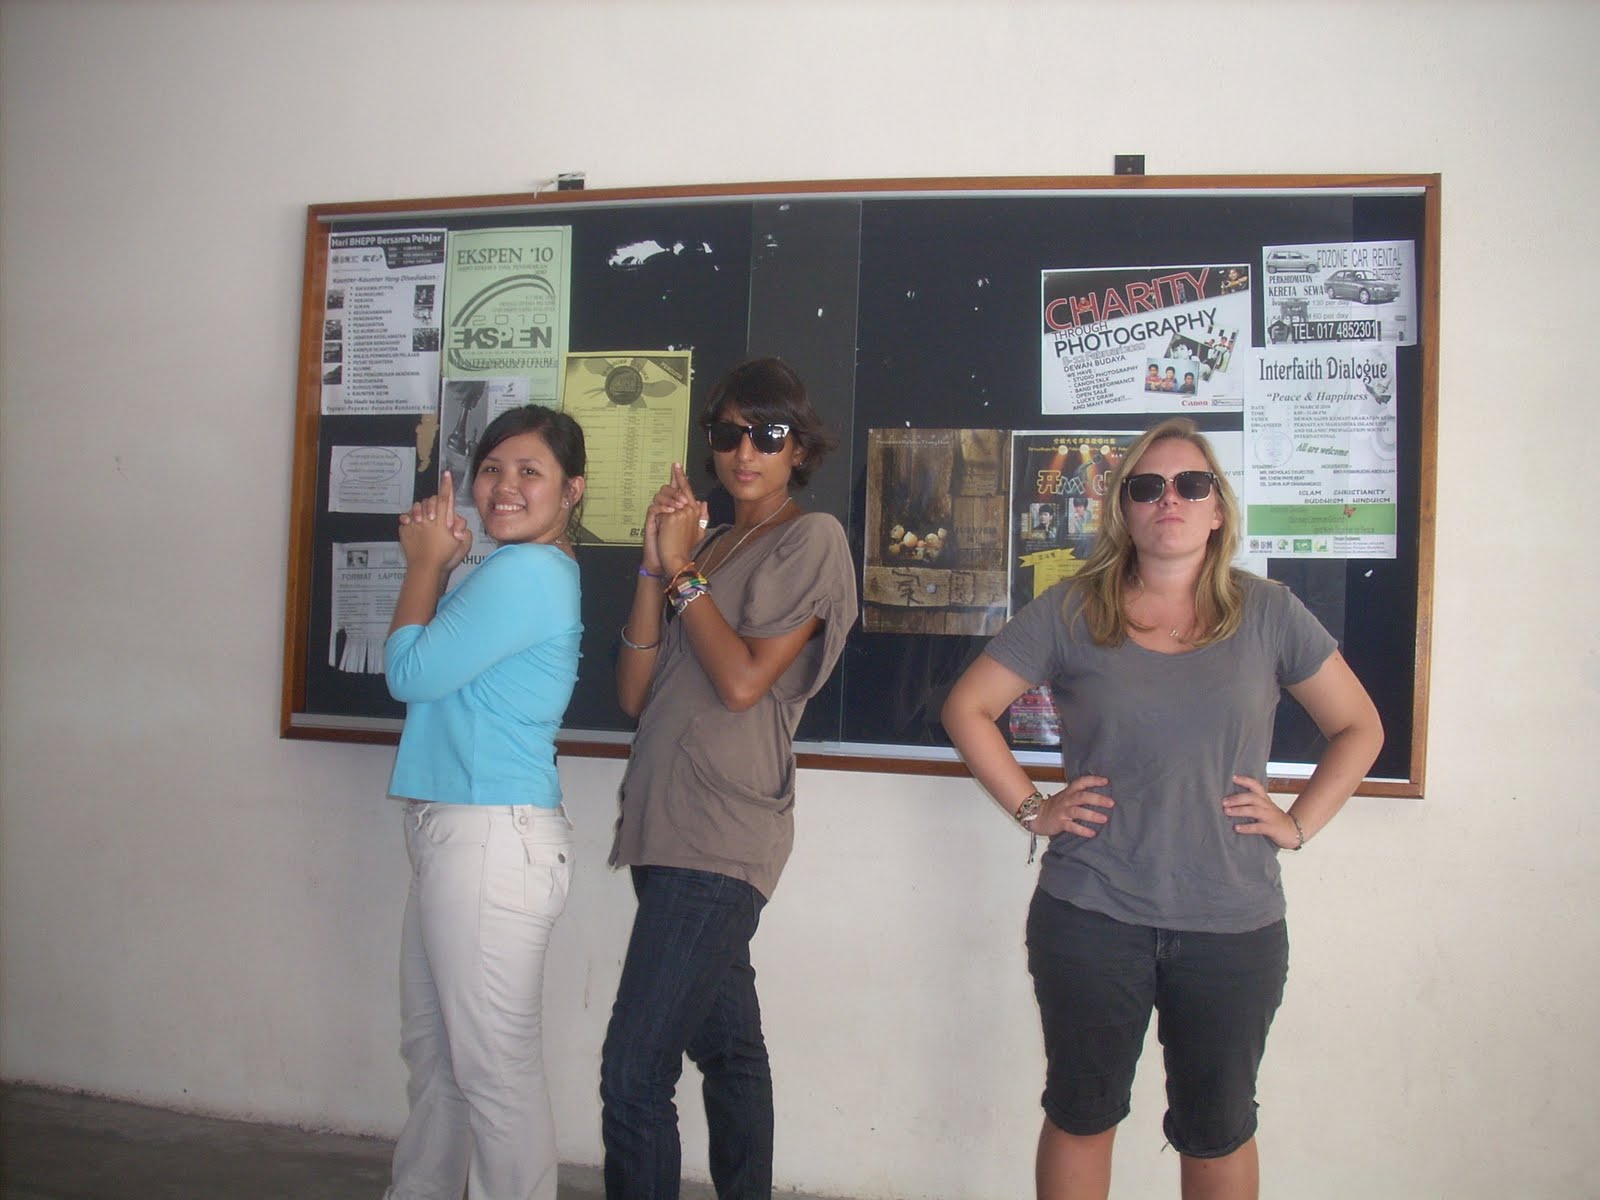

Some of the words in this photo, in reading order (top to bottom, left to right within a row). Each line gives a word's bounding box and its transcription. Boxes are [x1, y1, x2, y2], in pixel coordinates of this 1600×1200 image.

[331, 238, 348, 247] Hari
[349, 236, 376, 246] BHEPP
[377, 235, 411, 245] Bersama
[412, 233, 441, 244] Pelajar
[456, 247, 523, 265] EKSPEN
[530, 246, 554, 262] '10
[1352, 248, 1369, 267] CAR
[1372, 247, 1402, 267] RENTAL
[1268, 286, 1297, 297] KERETA
[1303, 285, 1324, 296] SEWA
[1045, 267, 1210, 331] CHARITY
[1338, 299, 1350, 307] day
[1336, 312, 1349, 320] day
[1052, 322, 1108, 340] THROUGH
[1055, 307, 1217, 358] PHOTOGRAPHY
[1292, 323, 1315, 340] TEL:
[1316, 322, 1335, 339] 017
[1337, 320, 1376, 338] 4852301
[453, 327, 552, 349] EKSPEN
[1064, 361, 1093, 373] DEWAN
[1094, 354, 1126, 367] BUDAYA
[1259, 357, 1323, 381] Interfaith
[1327, 356, 1388, 385] Dialogue
[1073, 373, 1095, 382] STUDIO
[1096, 365, 1138, 378] PHOTOGRAPHY
[1074, 380, 1095, 388] CANON
[1075, 386, 1092, 394] BAND
[1093, 377, 1135, 390] PERFORMANCE
[1076, 391, 1092, 399] OPEN
[1077, 396, 1096, 405] LUCKY
[1096, 392, 1114, 400] DRAW
[1304, 392, 1313, 401] &
[1073, 403, 1086, 411] AND
[1086, 400, 1104, 408] MANY
[1181, 399, 1209, 407] Canon
[1296, 442, 1308, 452] All
[1320, 446, 1349, 456] welcome
